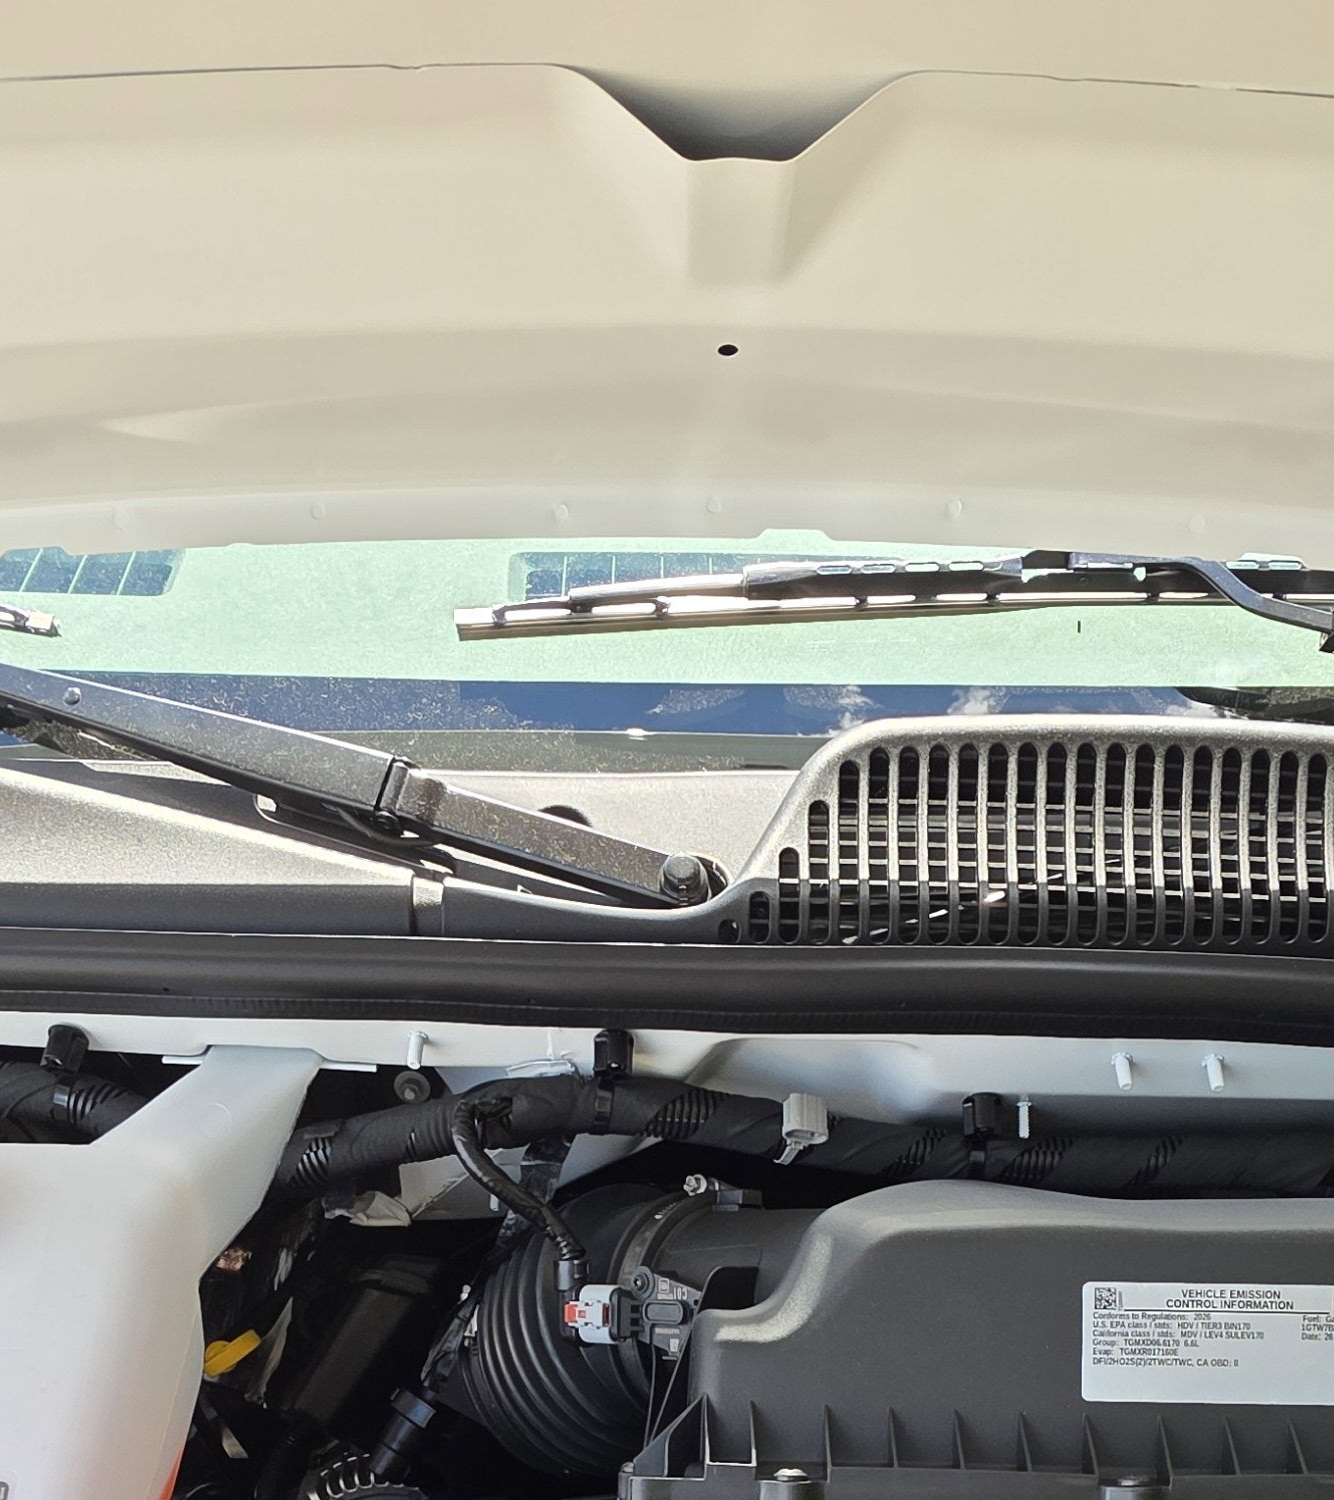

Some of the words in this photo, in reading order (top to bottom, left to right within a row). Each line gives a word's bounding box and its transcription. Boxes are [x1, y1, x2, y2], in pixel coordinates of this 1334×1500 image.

[1181, 1289, 1226, 1299] VEHICLE
[1229, 1289, 1281, 1300] EMISSION
[1165, 1299, 1218, 1310] CONTROL
[1219, 1299, 1294, 1311] INFORMATION
[1092, 1312, 1130, 1320] Conforms
[1131, 1312, 1140, 1320] to
[1141, 1313, 1189, 1322] Regulations:
[1302, 1315, 1322, 1323] Fuel:
[1092, 1321, 1107, 1329] U.S.
[1110, 1321, 1126, 1329] EPA
[1127, 1321, 1148, 1329] class
[1177, 1322, 1194, 1330] HDV
[1201, 1322, 1222, 1330] TIER3
[1092, 1330, 1130, 1338] California
[1131, 1330, 1151, 1338] class
[1180, 1330, 1198, 1338] MDV
[1204, 1331, 1224, 1339] LEV4
[1225, 1331, 1264, 1339] SULEV170
[1301, 1333, 1321, 1341] Date:
[1092, 1339, 1118, 1347] Group:
[1092, 1348, 1114, 1357] Evap:
[1196, 1359, 1208, 1367] CA
